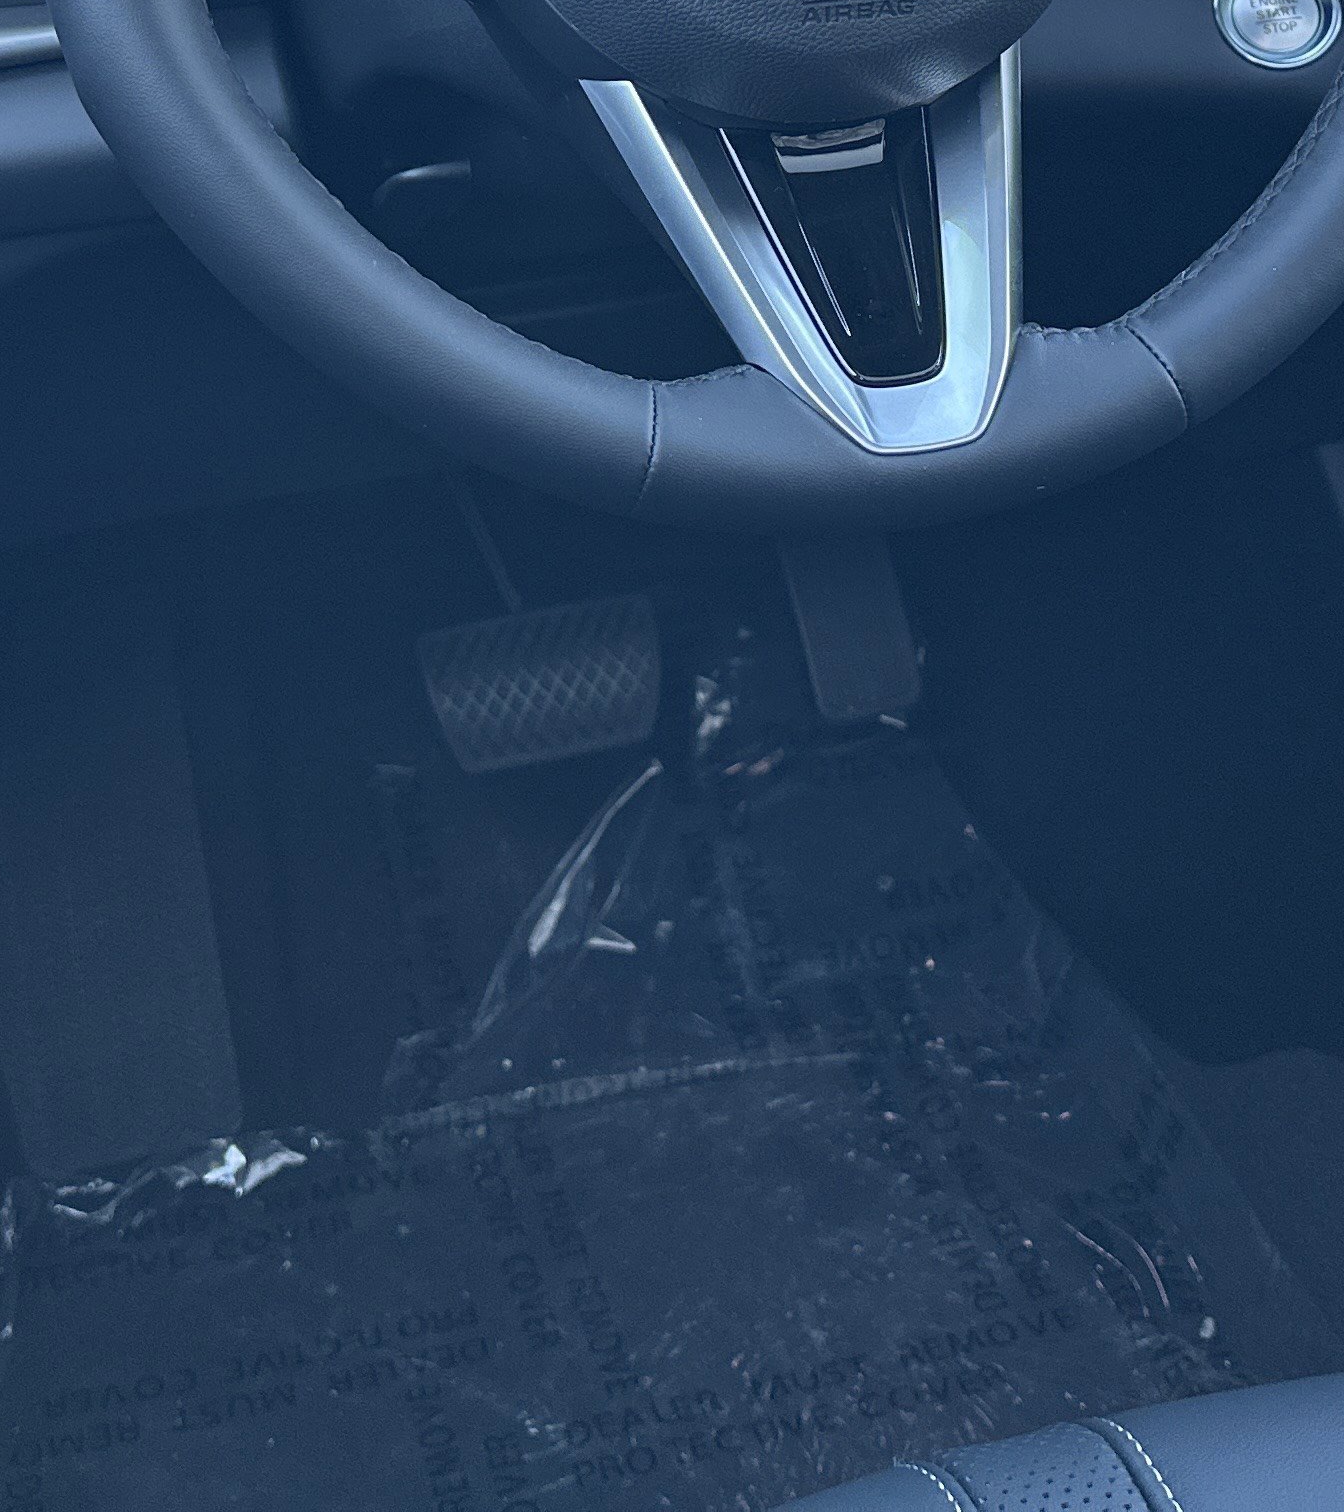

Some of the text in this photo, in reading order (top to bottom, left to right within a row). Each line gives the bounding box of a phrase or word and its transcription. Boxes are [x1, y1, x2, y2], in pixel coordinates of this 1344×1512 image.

[1256, 5, 1298, 21] START
[1263, 21, 1298, 36] STOP
[563, 1388, 726, 1449] DEALER
[900, 1307, 1077, 1371] REMOVE
